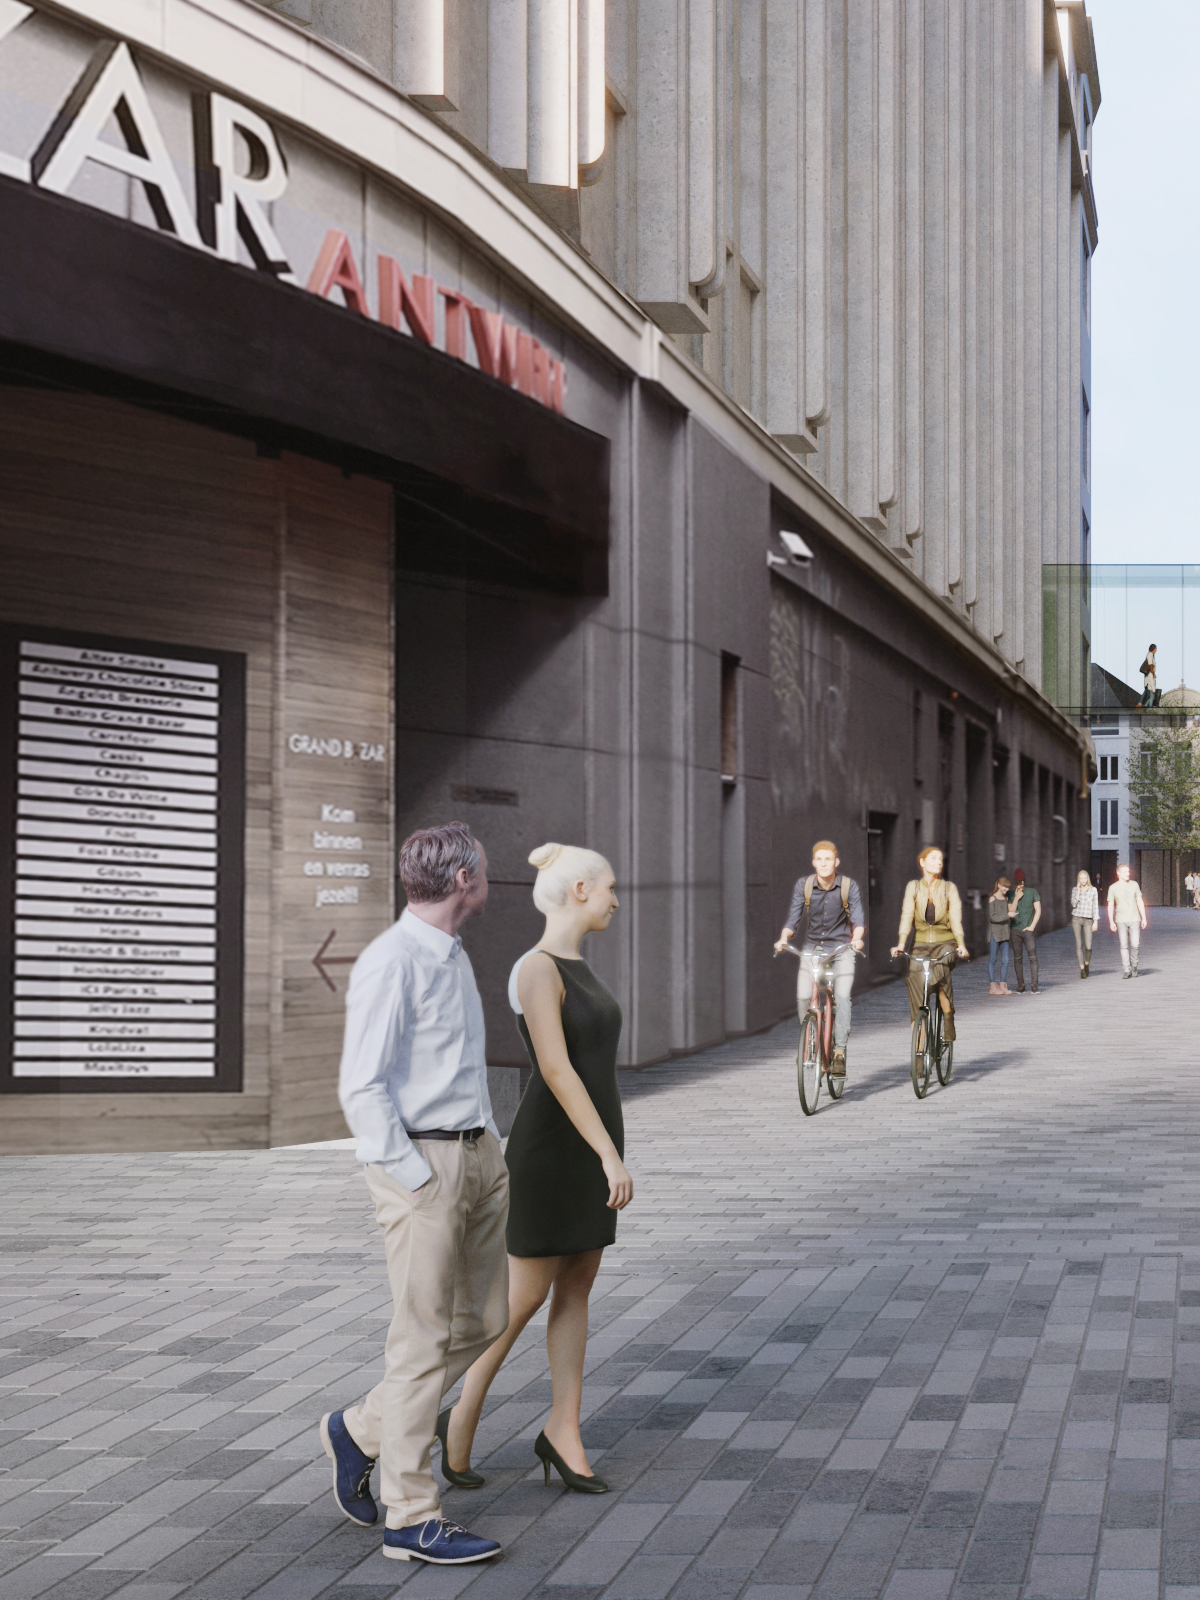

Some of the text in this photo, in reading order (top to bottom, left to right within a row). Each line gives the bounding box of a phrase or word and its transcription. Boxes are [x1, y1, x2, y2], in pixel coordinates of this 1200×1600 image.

[32, 663, 206, 693] Antwerp Chocolate Store
[118, 692, 183, 708] Brasserie
[54, 706, 186, 730] Bistro Grand Bazar
[88, 729, 156, 744] Carrefour
[288, 733, 386, 762] GRAND BZAR
[320, 804, 356, 823] Kom
[312, 830, 363, 850] binnen
[303, 861, 371, 878] en verras
